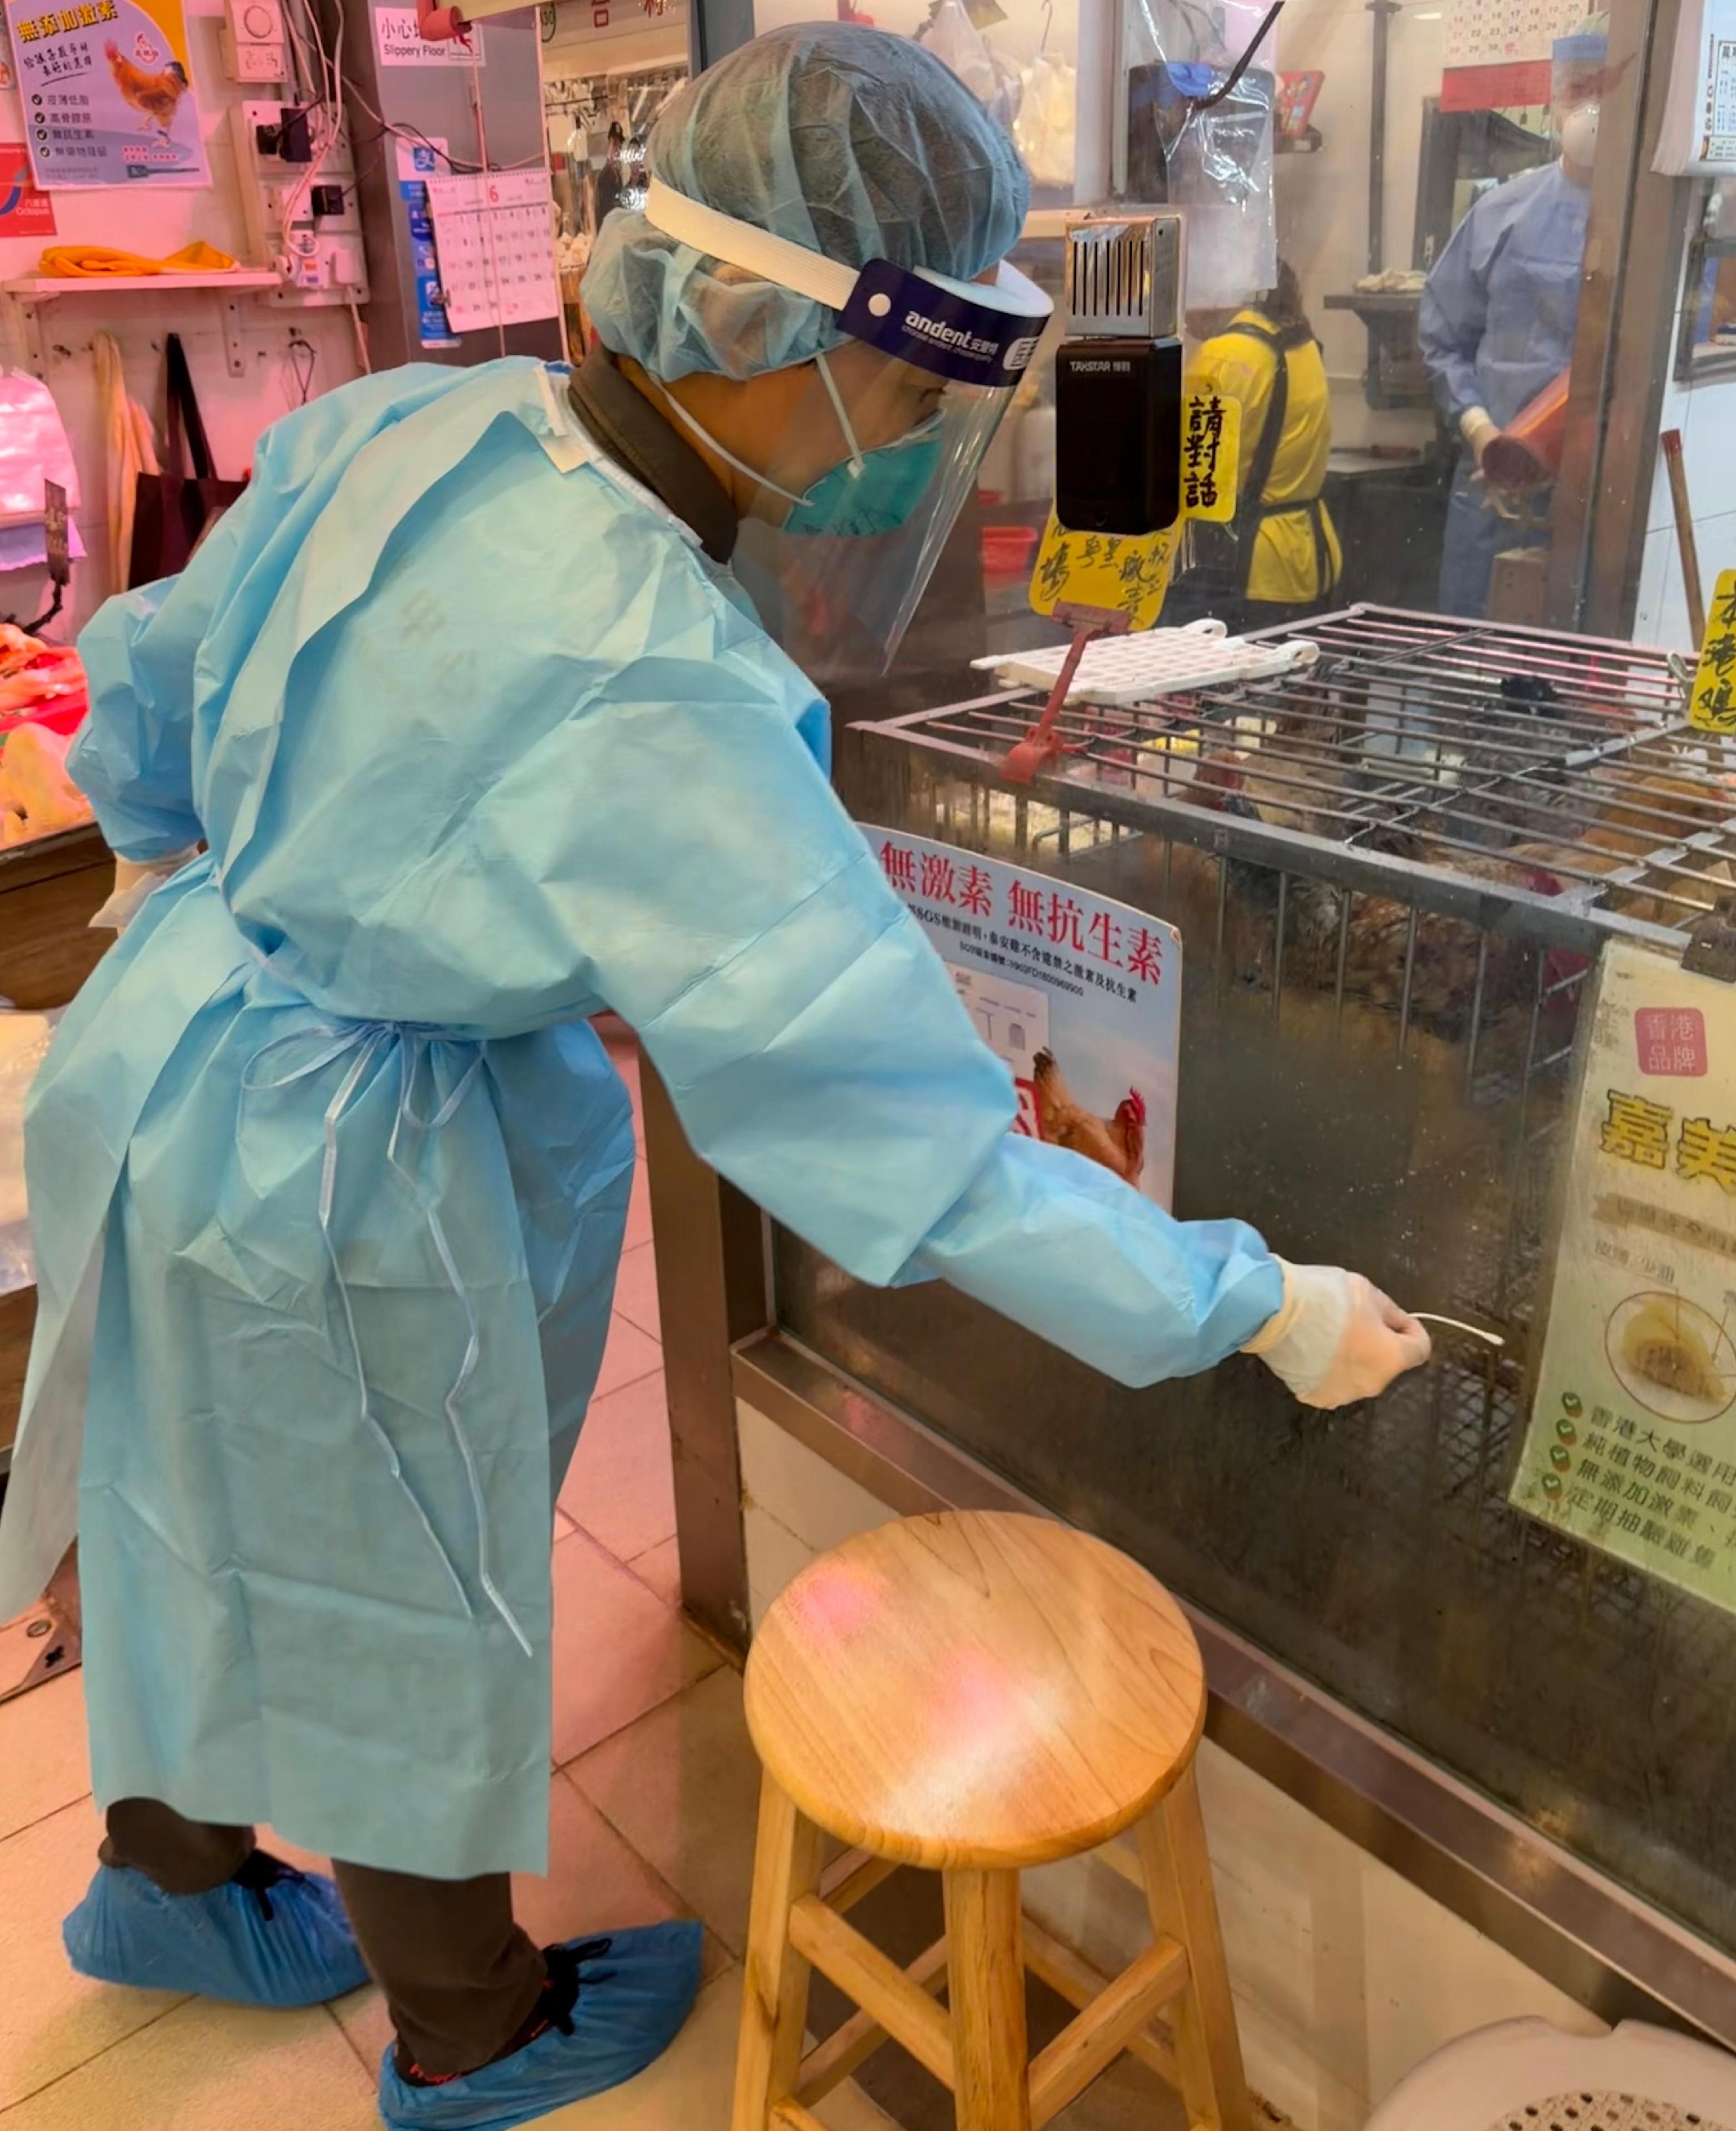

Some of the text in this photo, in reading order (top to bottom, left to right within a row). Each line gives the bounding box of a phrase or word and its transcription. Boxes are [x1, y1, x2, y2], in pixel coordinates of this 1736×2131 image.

[384, 44, 445, 58] Slippery Floor
[489, 185, 499, 202] 6
[906, 311, 972, 348] andent
[1069, 361, 1111, 372] TAKSTAR
[1184, 396, 1227, 508] 請對話
[880, 841, 1162, 986] 無激素 無抗生素
[1645, 1014, 1694, 1042] 香港
[1648, 1045, 1696, 1072] 品牌
